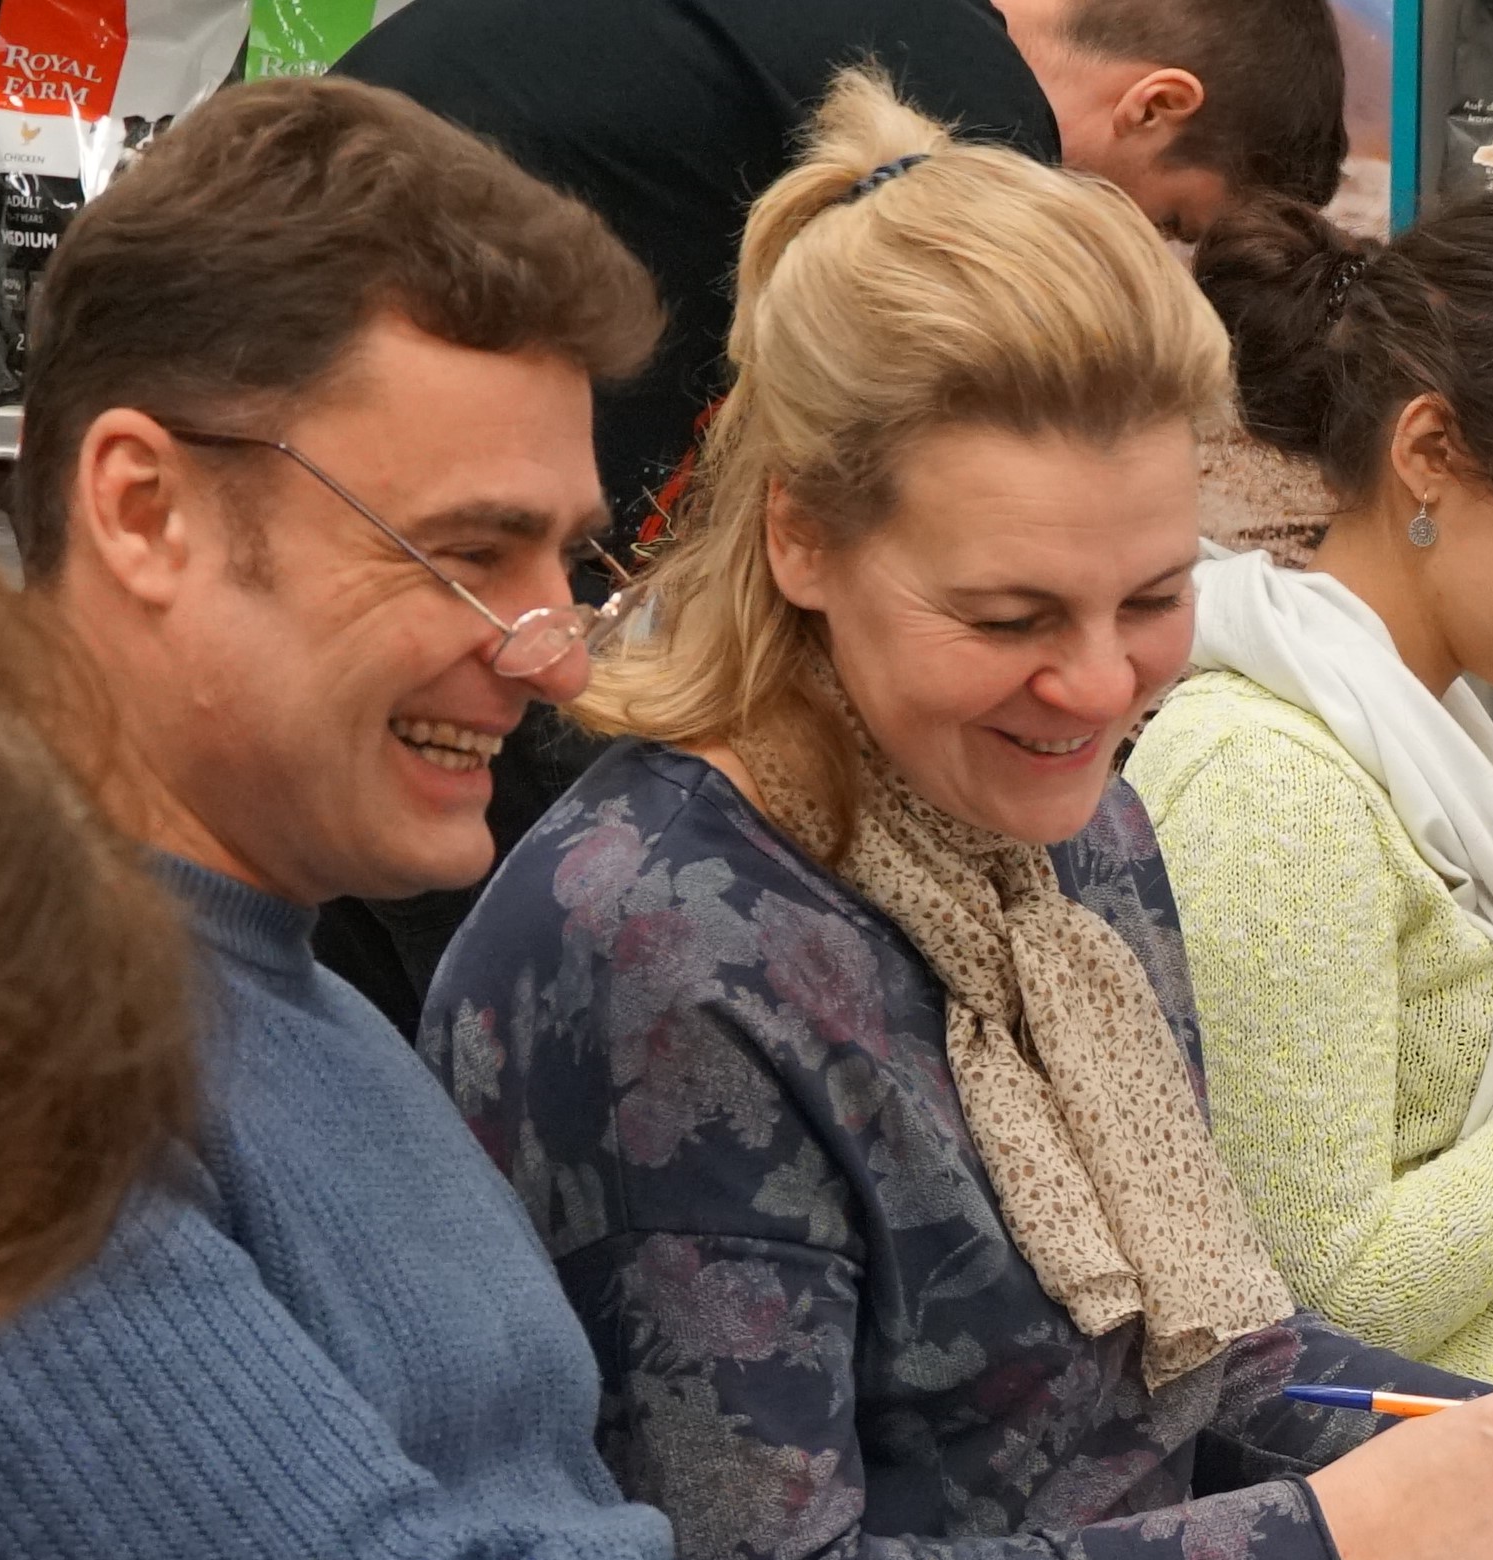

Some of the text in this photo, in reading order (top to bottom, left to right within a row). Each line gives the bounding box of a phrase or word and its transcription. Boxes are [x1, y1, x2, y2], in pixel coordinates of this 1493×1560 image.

[2, 44, 103, 84] ROYAL
[2, 76, 90, 106] FARM
[1464, 100, 1484, 114] Auf
[4, 152, 45, 164] CHICKEN
[5, 196, 42, 209] ADULT
[2, 231, 58, 249] MEDIUM
